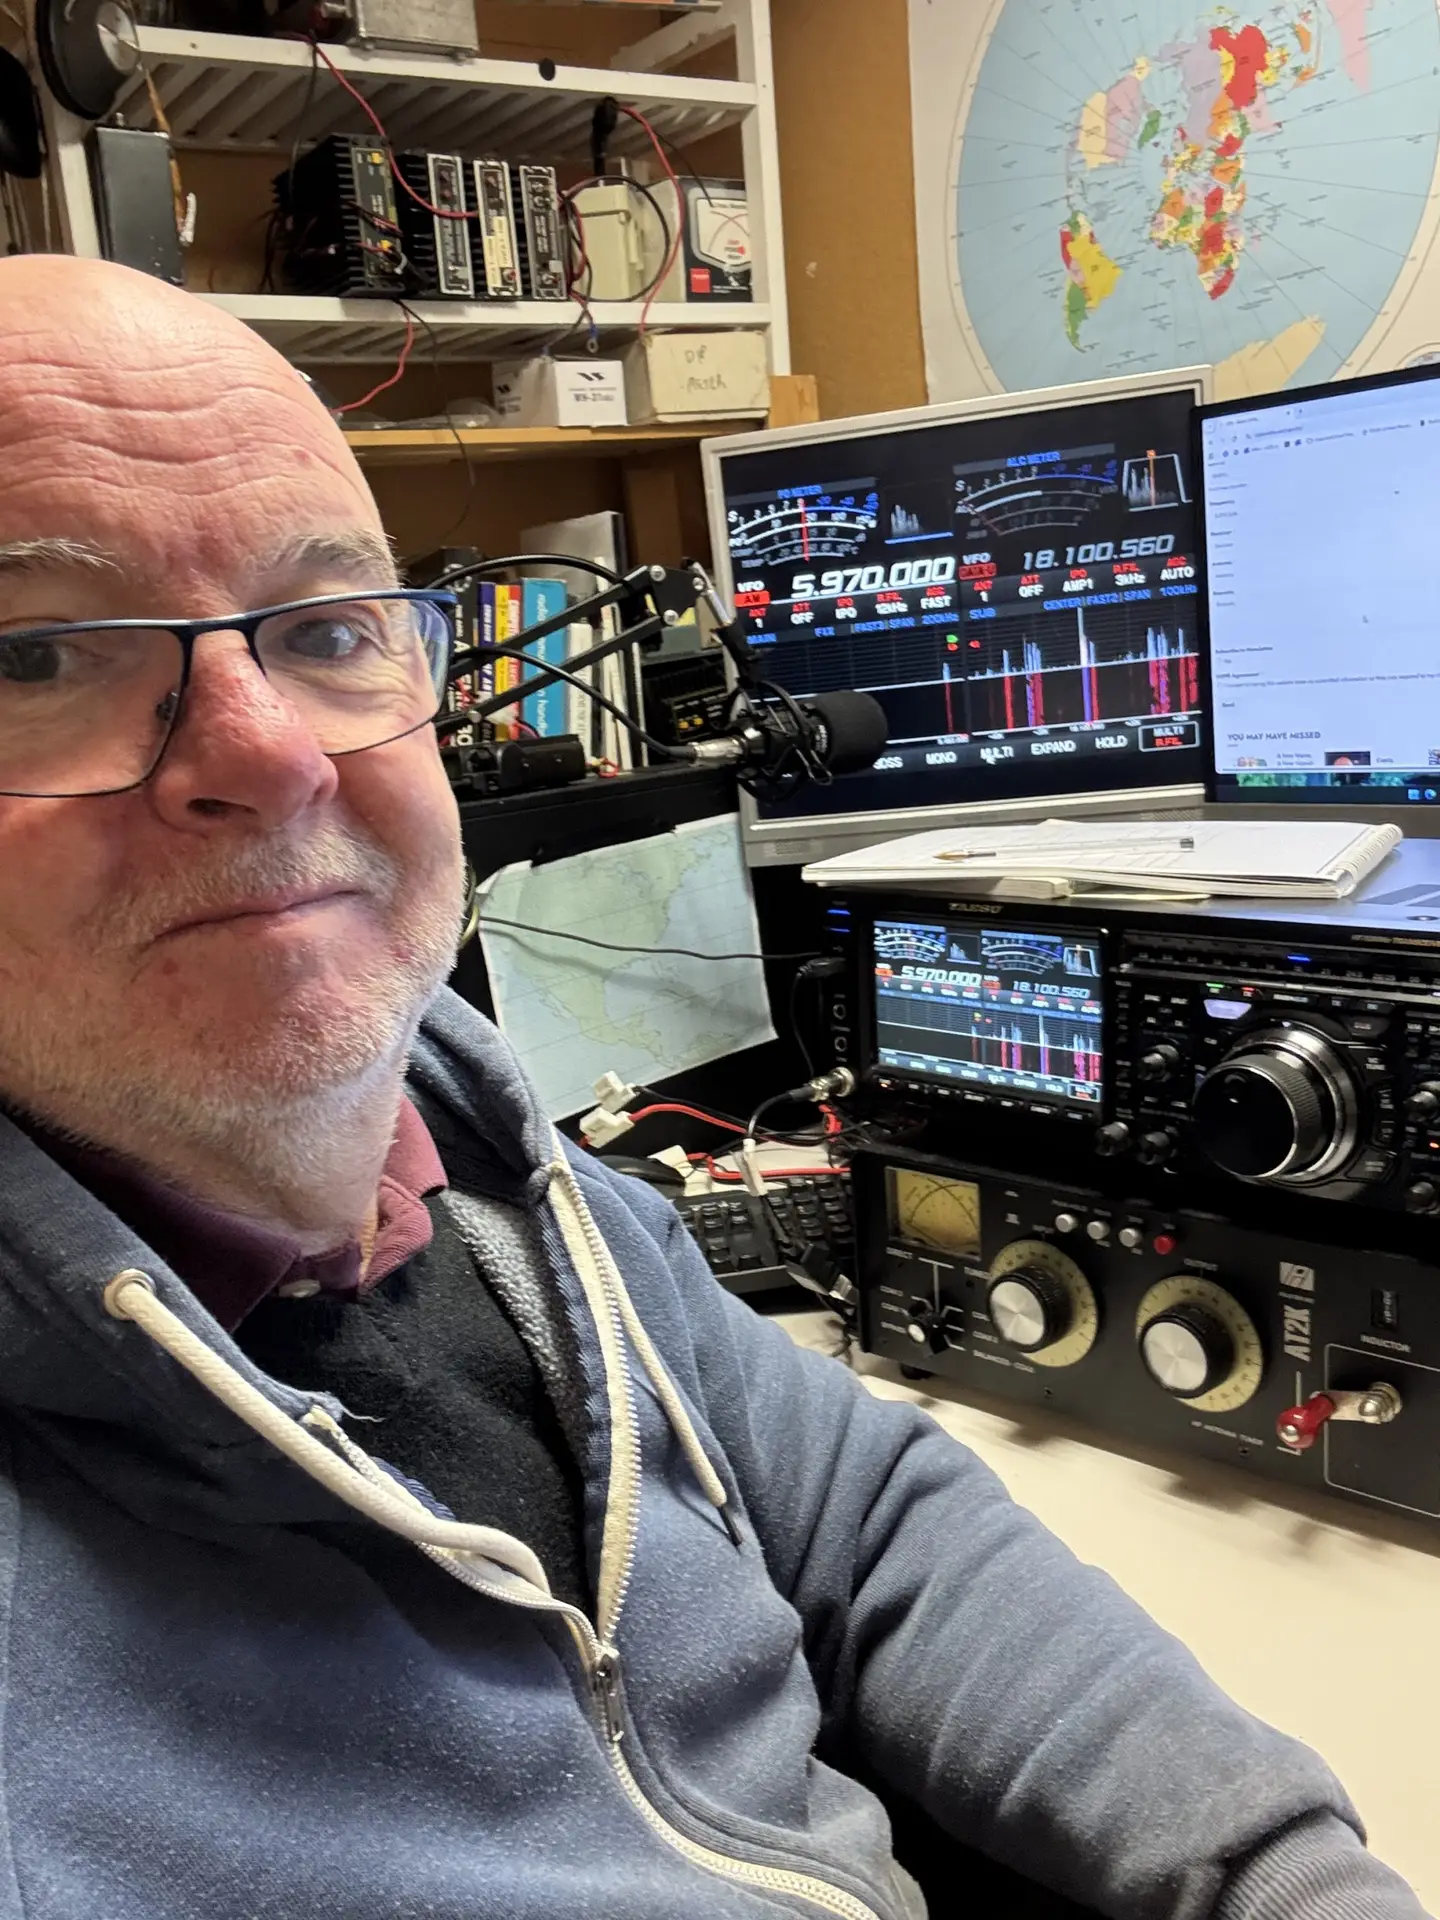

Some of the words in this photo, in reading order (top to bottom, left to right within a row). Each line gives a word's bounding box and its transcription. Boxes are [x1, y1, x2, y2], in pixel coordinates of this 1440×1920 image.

[962, 552, 991, 565] VFO
[1022, 534, 1175, 571] 18.100.560
[791, 556, 956, 599] 5.970.000
[1115, 573, 1146, 586] 3kHz
[1160, 566, 1195, 580] AUTO
[737, 580, 765, 592] VFO
[1019, 584, 1044, 598] OFF
[920, 595, 952, 609] FAST
[790, 612, 815, 625] OFF
[1227, 733, 1244, 741] YOU
[1289, 731, 1321, 740] MISSED
[925, 751, 958, 765] MONO
[1030, 740, 1076, 756] EXPAND
[1095, 735, 1128, 749] HOLD
[901, 965, 982, 987] 5.970.000
[1013, 980, 1091, 999] 18.100.560
[1283, 1304, 1313, 1362] AT2K
